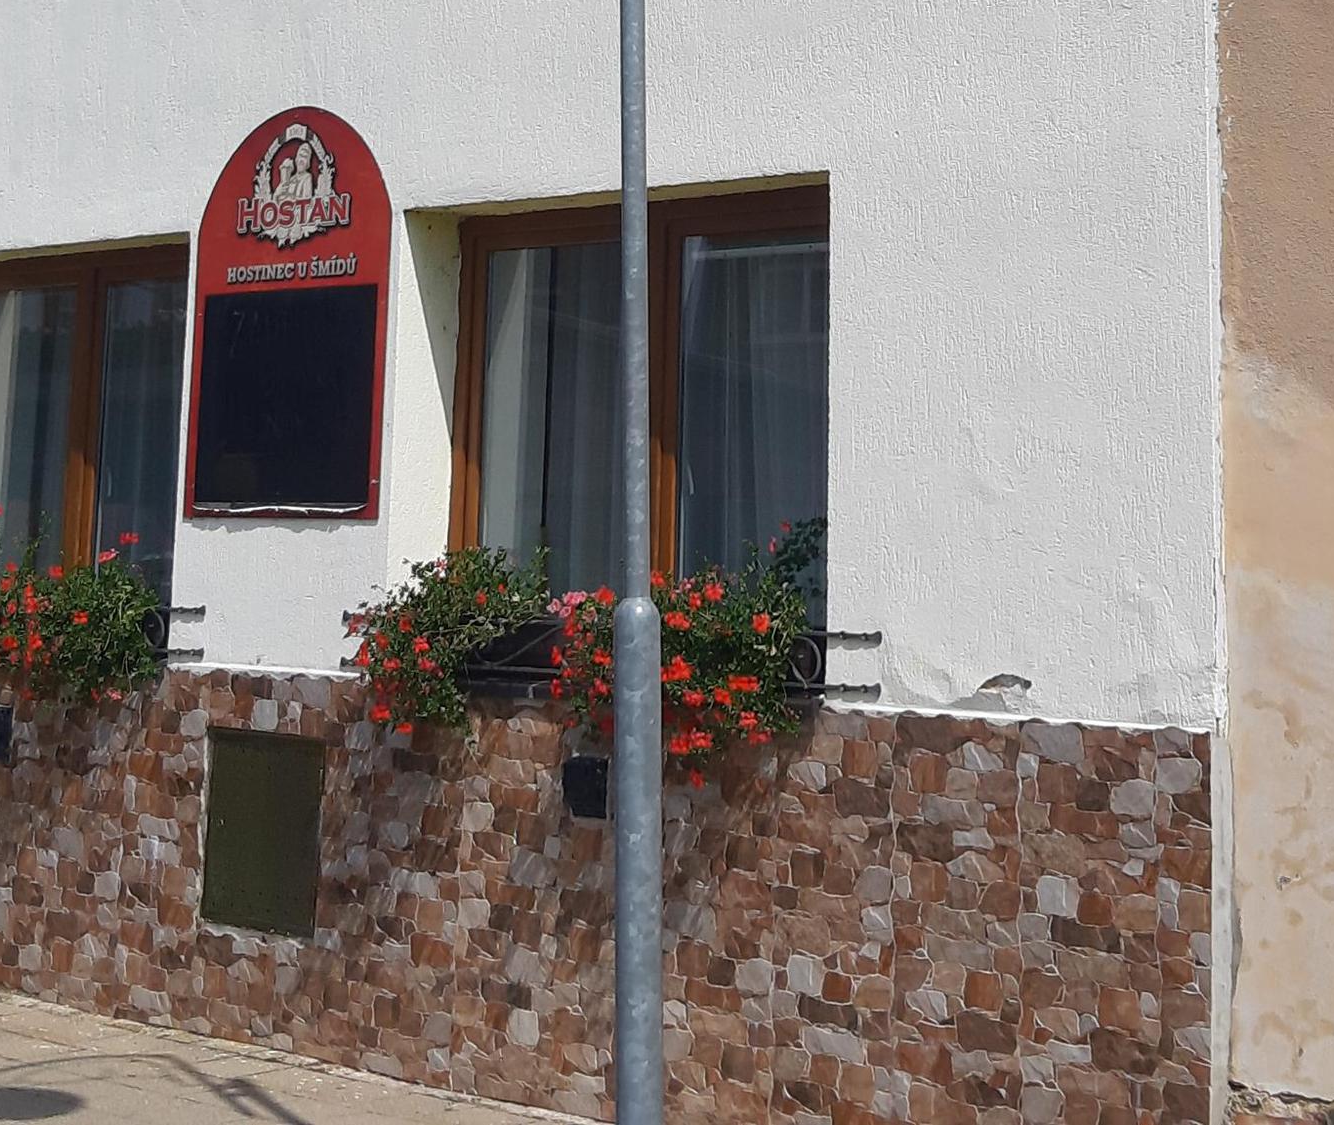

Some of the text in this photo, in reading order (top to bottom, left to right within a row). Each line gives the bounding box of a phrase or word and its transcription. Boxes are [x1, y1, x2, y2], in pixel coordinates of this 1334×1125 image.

[237, 193, 352, 234] HOSTAN
[227, 252, 357, 283] HOSTINEC U ŠMÍDŮ
